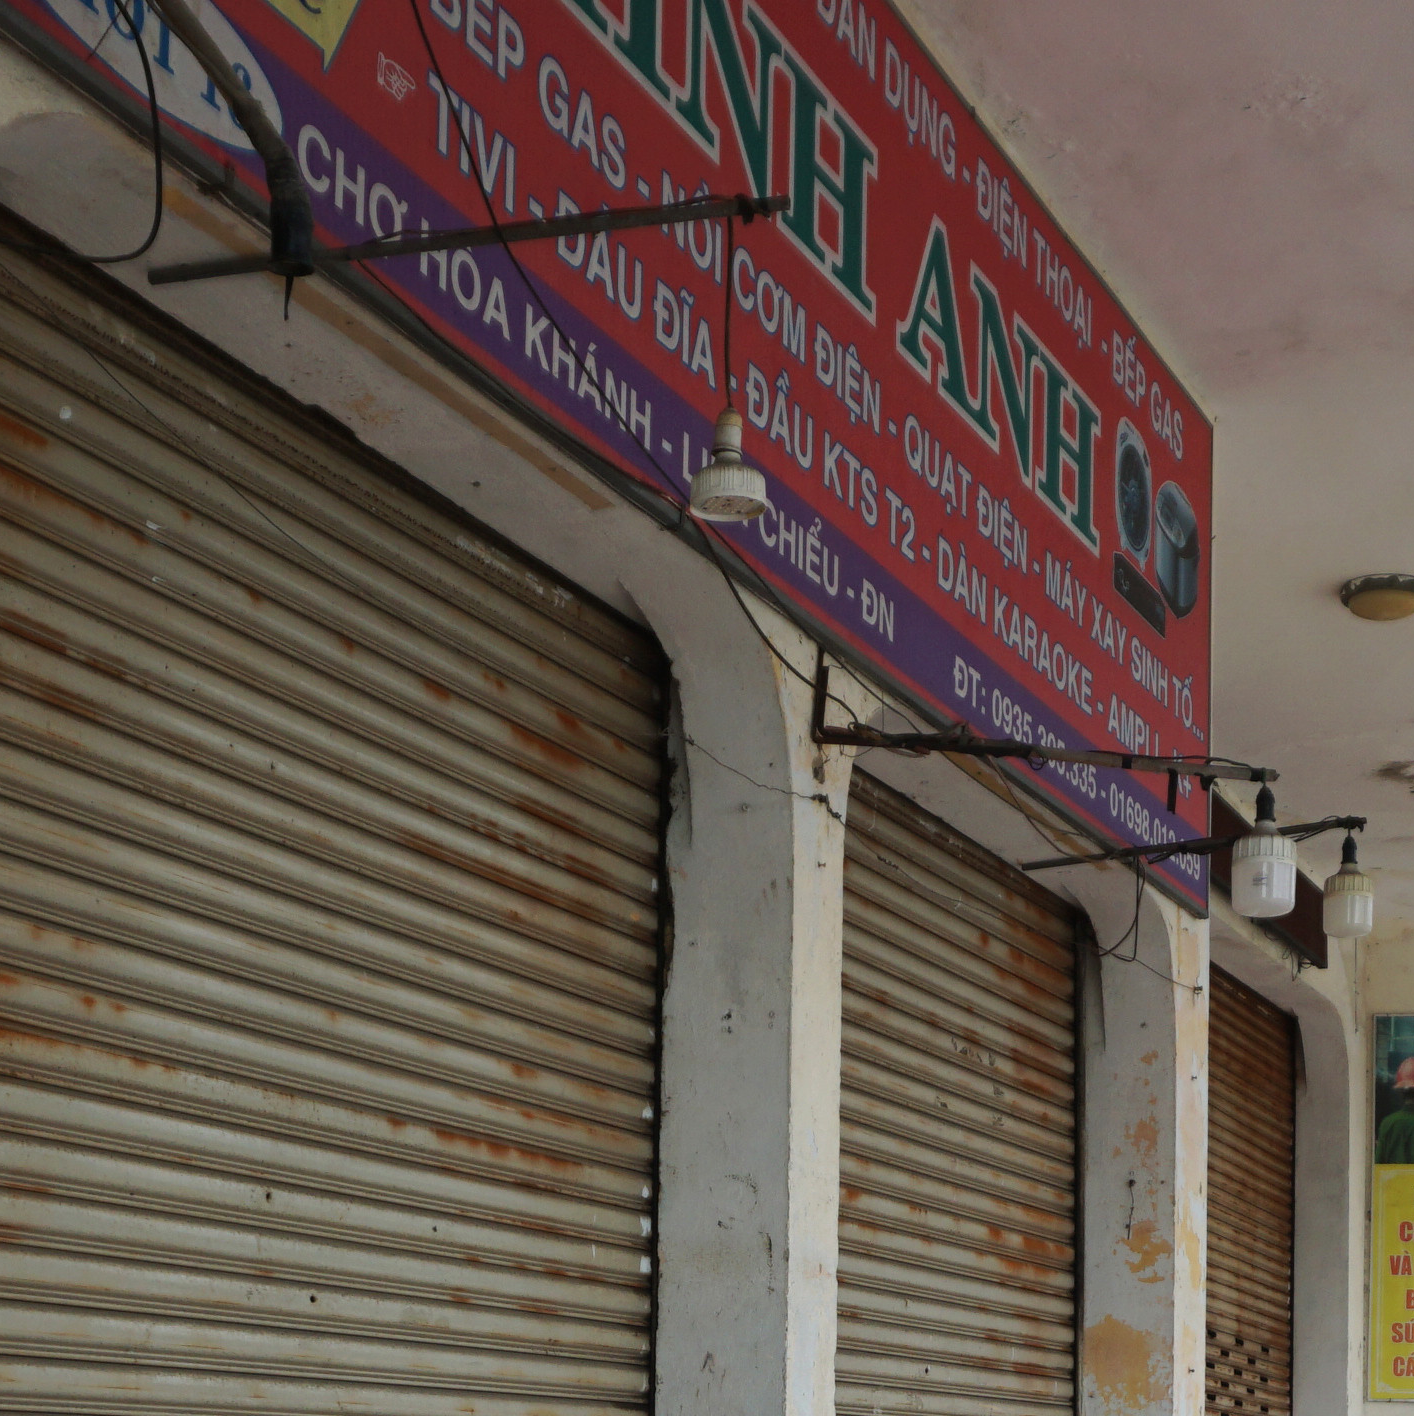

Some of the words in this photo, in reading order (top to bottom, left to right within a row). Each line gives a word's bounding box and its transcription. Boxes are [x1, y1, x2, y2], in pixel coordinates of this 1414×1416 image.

[427, 68, 516, 217] TIVI
[653, 277, 717, 393] ĐĨA
[746, 360, 814, 471] ĐẦU
[823, 430, 879, 528] KTS
[885, 486, 916, 563] T2
[937, 533, 987, 626] DÀN
[992, 585, 1093, 716] KARAOKE
[538, 54, 626, 191] GAS
[732, 246, 806, 366] CƠM
[813, 322, 881, 436] ĐIỆN
[903, 413, 973, 519] QUẠT
[975, 482, 1028, 576] ĐIỆN
[1045, 550, 1087, 628] MÁY
[1090, 595, 1128, 666] XAY
[1130, 636, 1169, 709] SINH
[885, 36, 956, 181] DỤNG
[976, 156, 1027, 270] ĐIỆN
[1033, 227, 1092, 350] THOẠI
[1112, 330, 1146, 407] BẾP
[1150, 381, 1183, 461] GAS
[895, 212, 1102, 560] ANH
[525, 302, 652, 451] KHÁNH
[758, 497, 839, 597] CHIỂU
[860, 578, 895, 643] ĐN
[953, 655, 986, 715] ĐT:
[1389, 1250, 1412, 1276] VÀ
